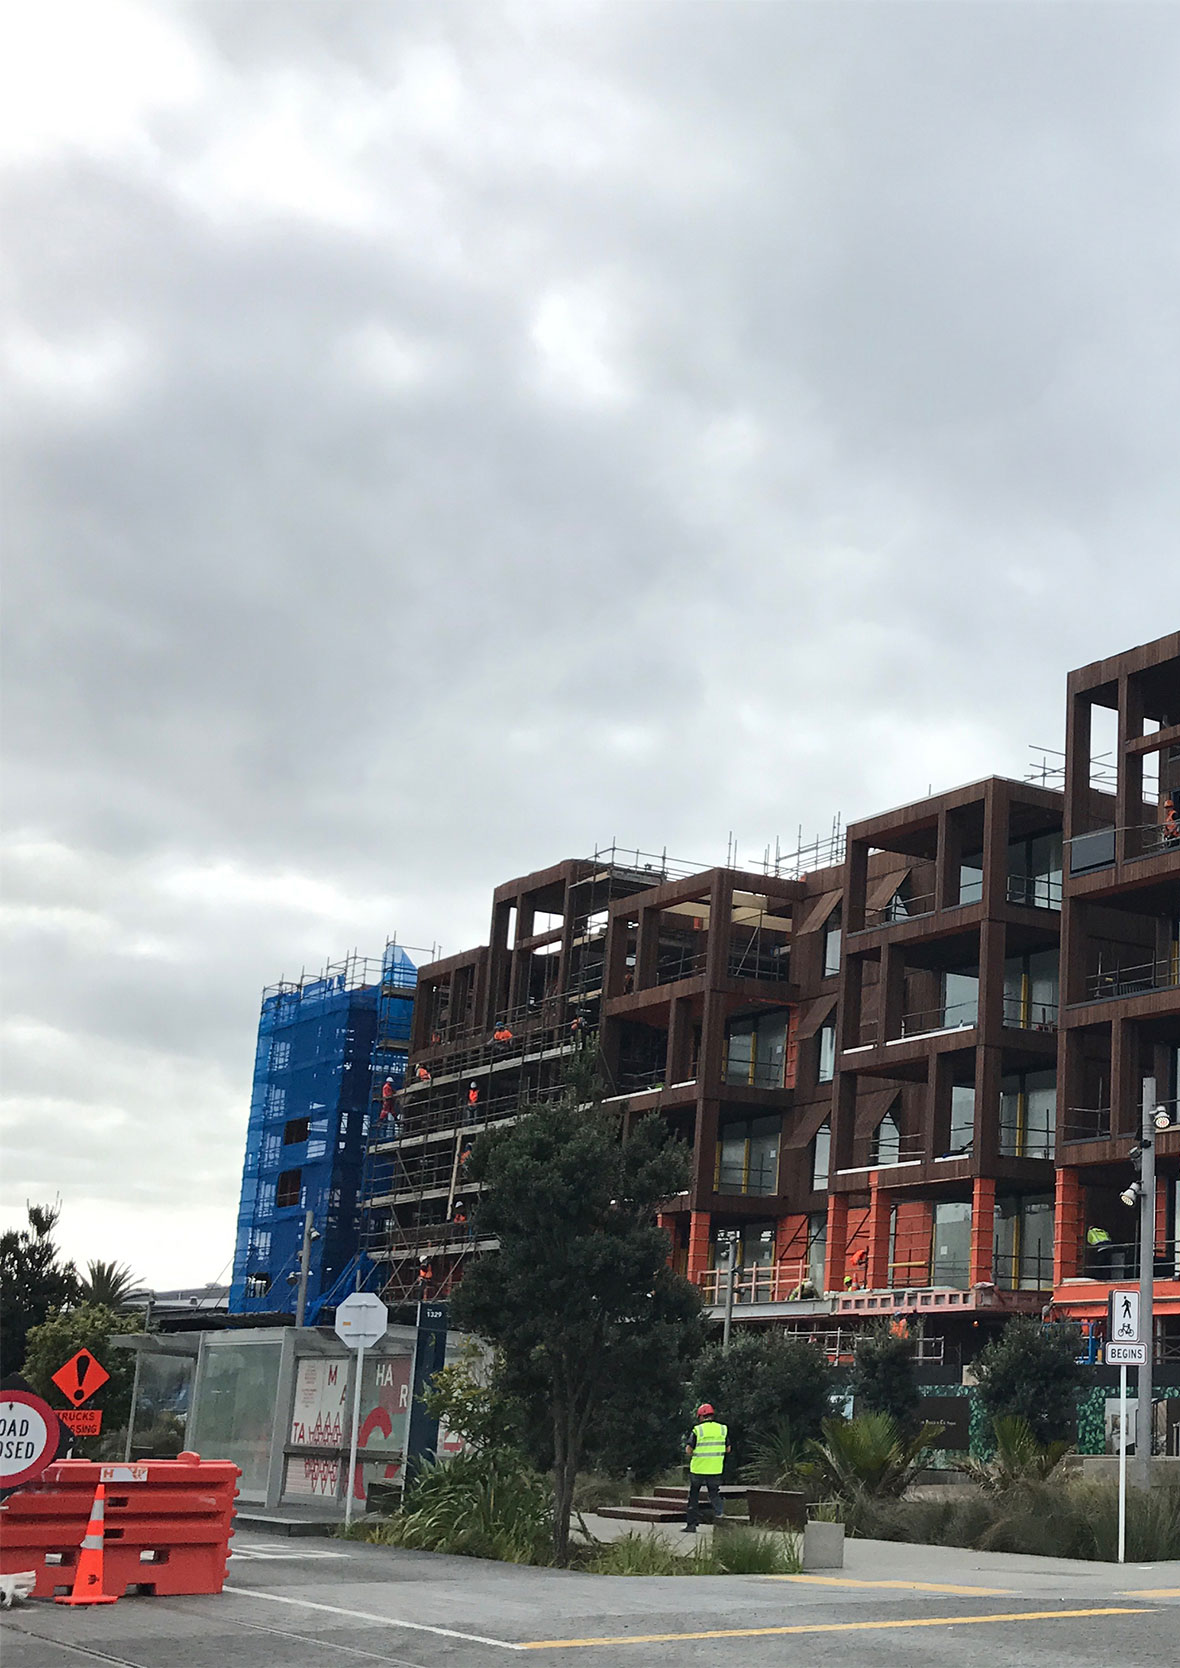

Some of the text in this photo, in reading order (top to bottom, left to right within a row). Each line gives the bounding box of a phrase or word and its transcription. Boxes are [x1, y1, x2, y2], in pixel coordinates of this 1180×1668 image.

[1110, 1348, 1143, 1359] BEGINS
[0, 1418, 29, 1437] OAD
[70, 1424, 97, 1434] SSING
[0, 1441, 35, 1459] SED
